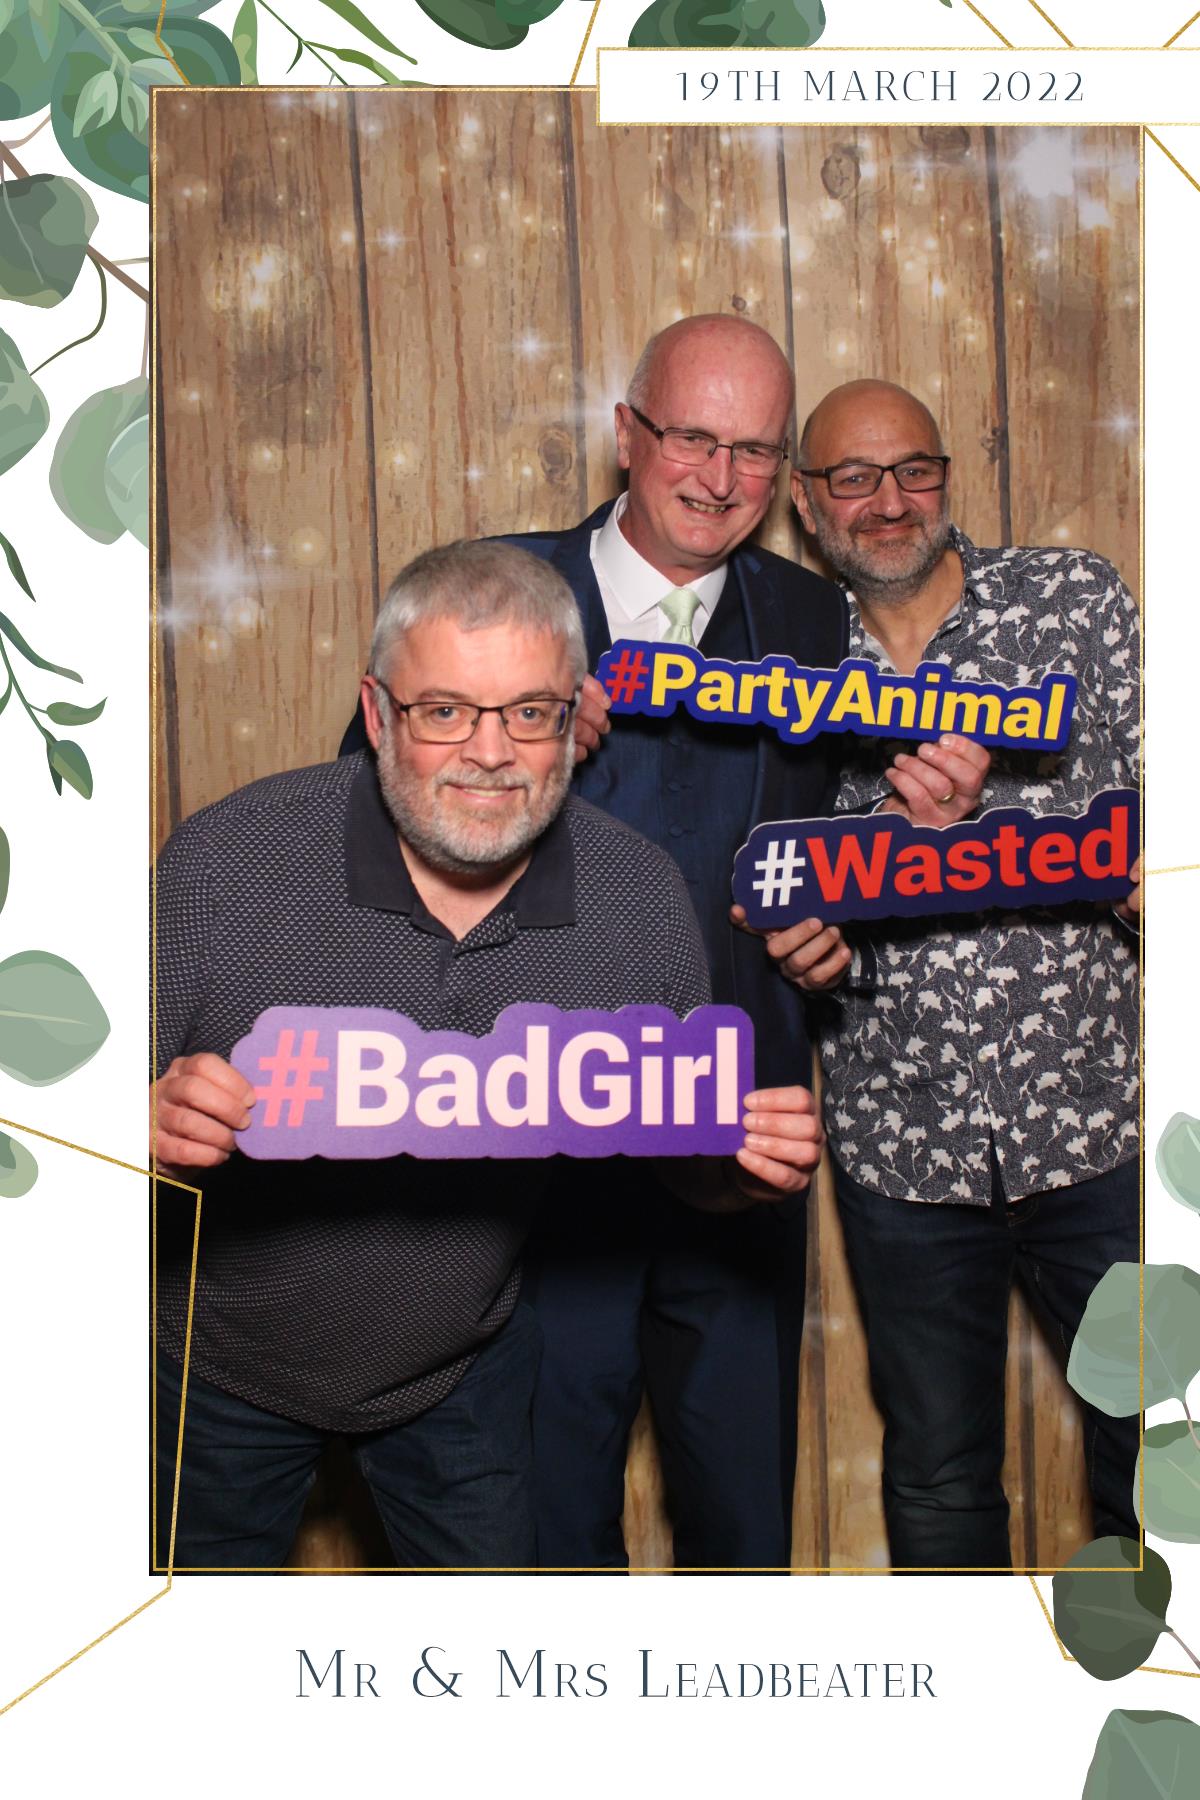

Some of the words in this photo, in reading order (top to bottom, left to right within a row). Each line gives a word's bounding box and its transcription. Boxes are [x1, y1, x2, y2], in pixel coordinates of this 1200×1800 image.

[605, 649, 1067, 741] #PartyAnimal
[752, 806, 1130, 909] #Wasted
[253, 1025, 740, 1128] #BadGirl
